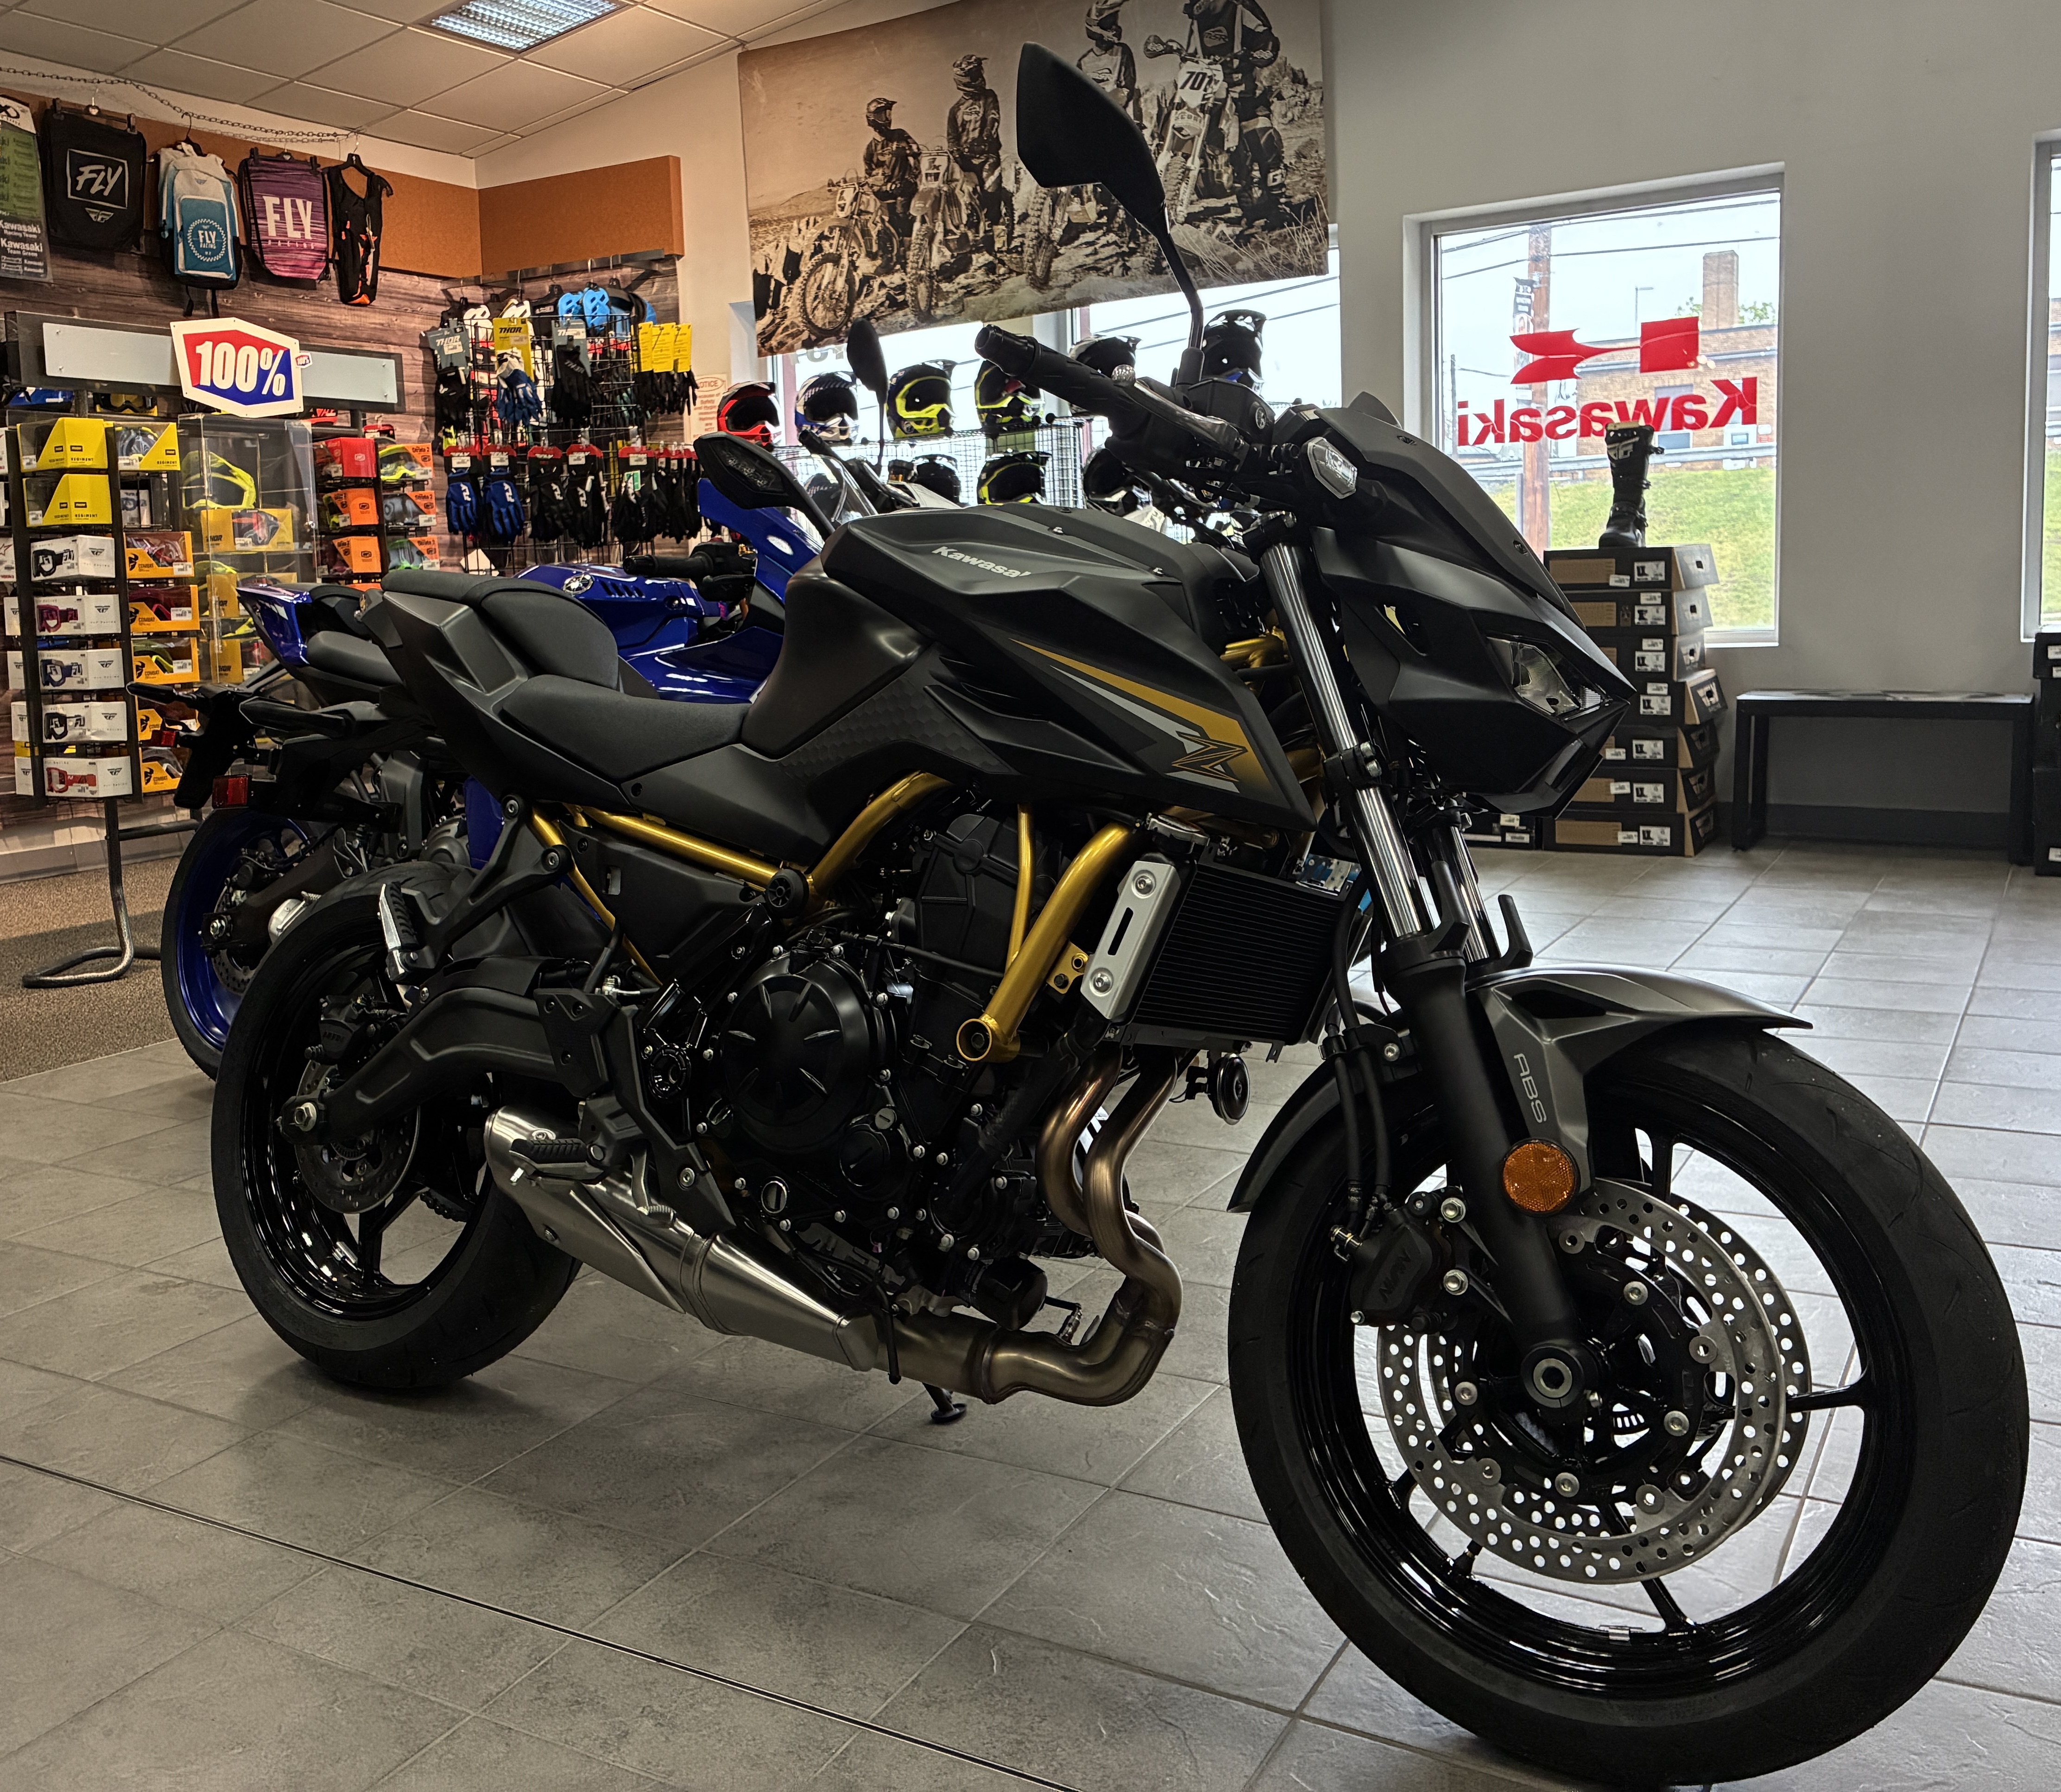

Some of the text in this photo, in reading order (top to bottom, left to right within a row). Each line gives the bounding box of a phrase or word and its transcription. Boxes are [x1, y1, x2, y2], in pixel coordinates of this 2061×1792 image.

[76, 165, 123, 196] FLY
[262, 196, 312, 240] FLY
[0, 237, 43, 252] Kawasaki
[198, 230, 216, 244] FLY
[436, 335, 460, 347] THOR
[196, 341, 285, 396] 100%
[931, 546, 1031, 578] Kawasa
[1513, 1053, 1547, 1123] ABS
